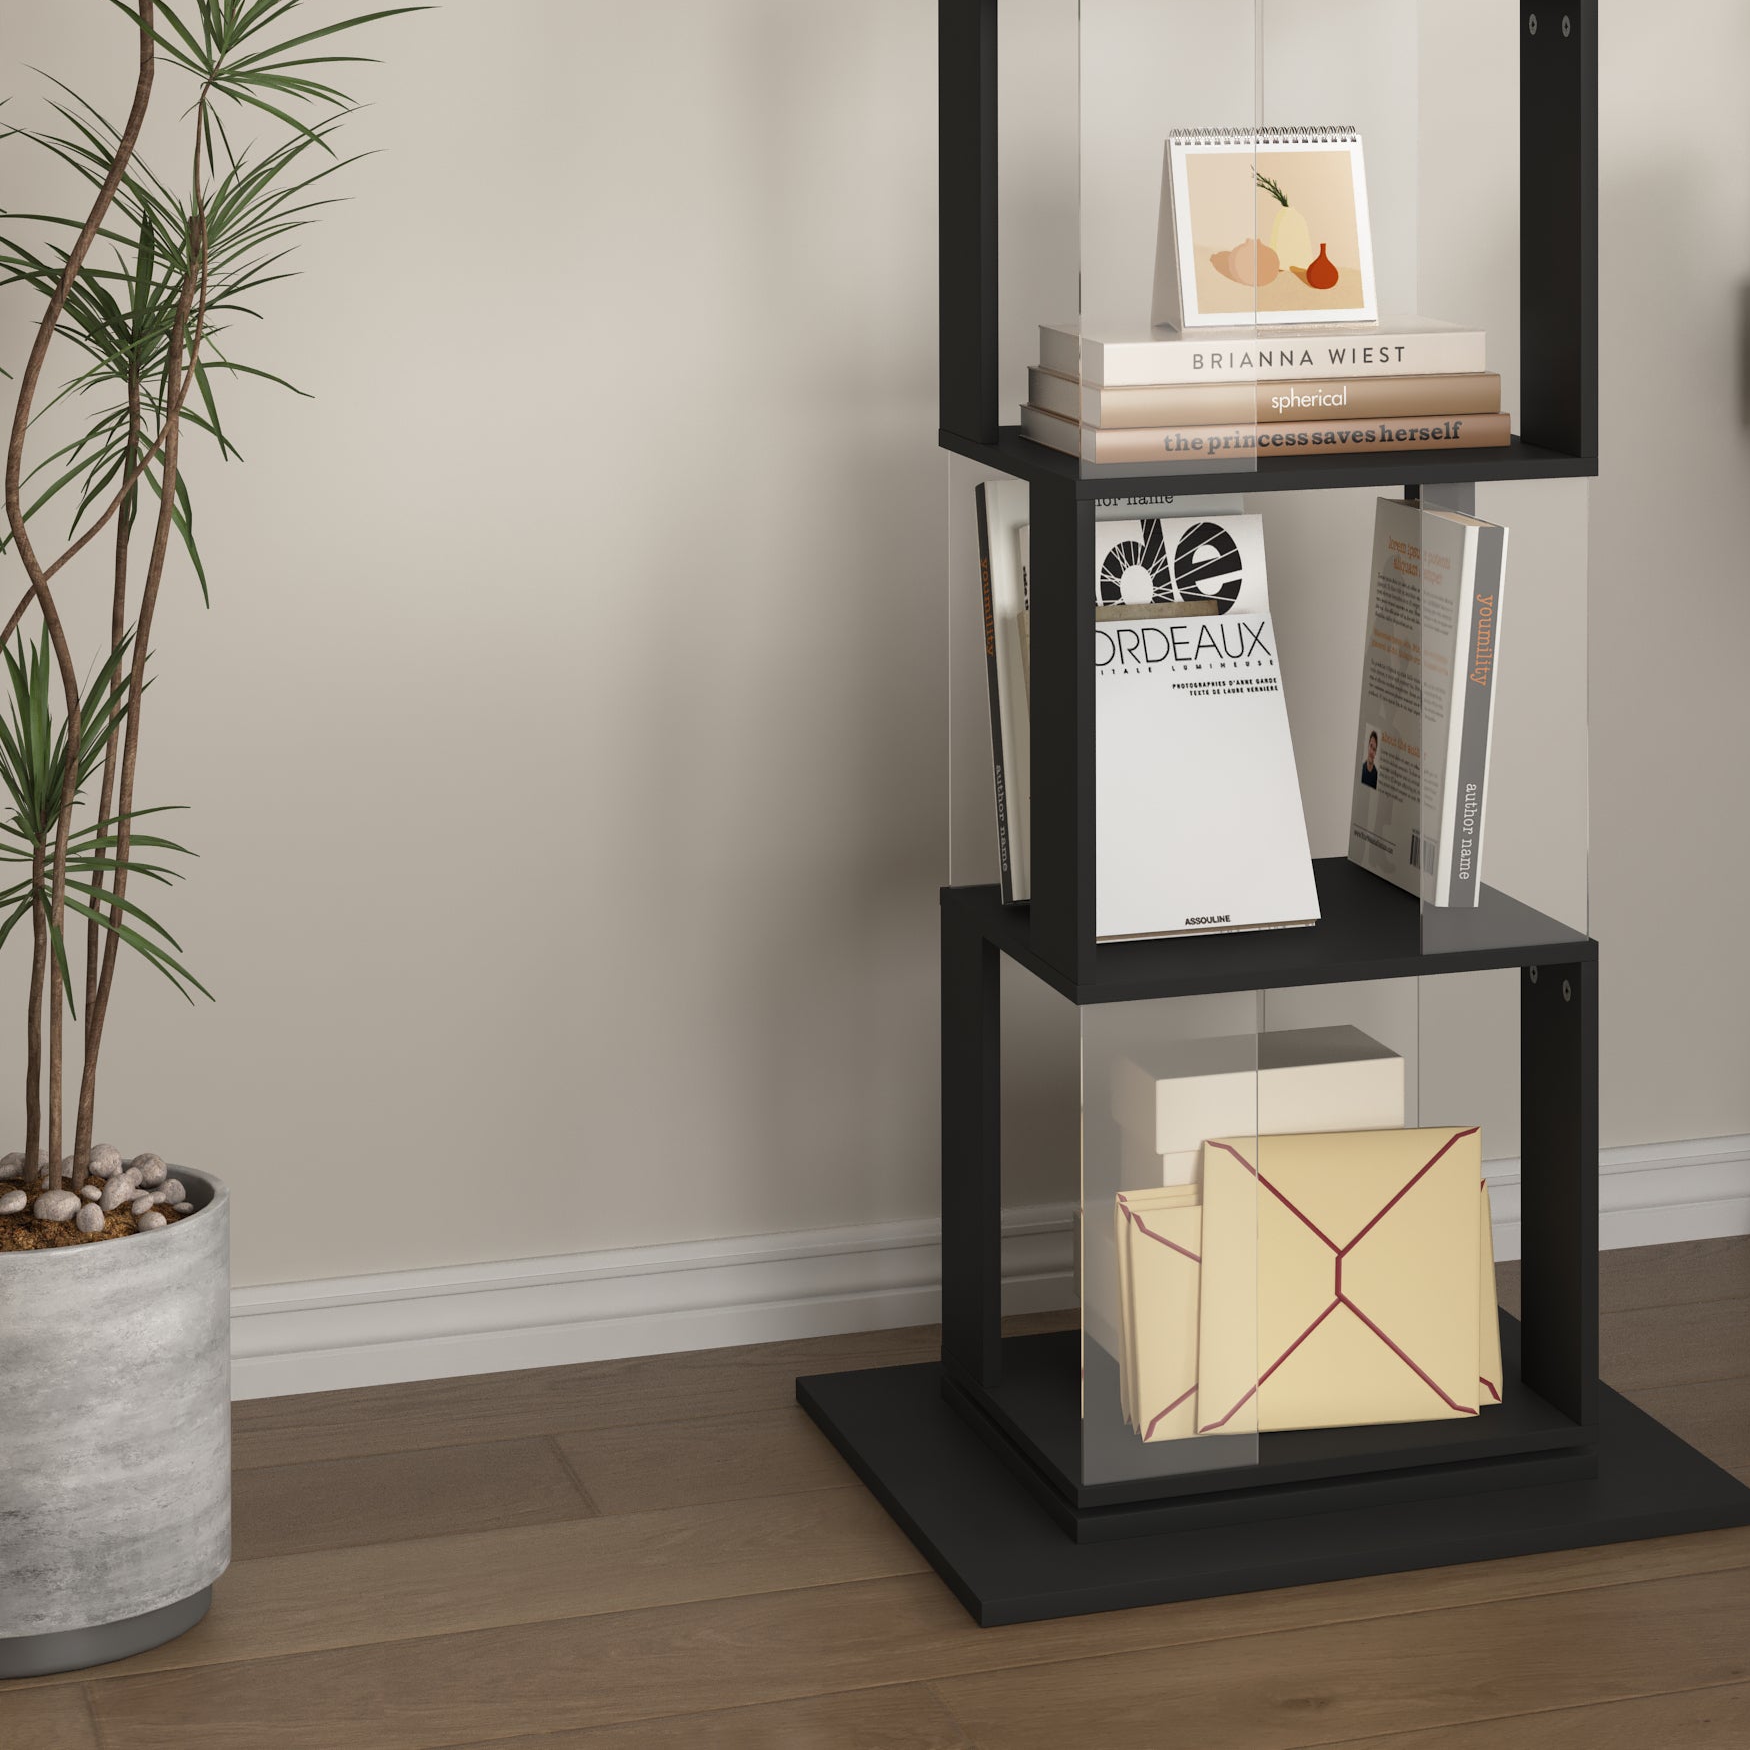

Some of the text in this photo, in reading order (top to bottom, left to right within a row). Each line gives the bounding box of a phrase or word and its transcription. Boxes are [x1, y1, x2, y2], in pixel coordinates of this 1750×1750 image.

[1193, 346, 1405, 370] BRIANNA WIEST
[1271, 385, 1347, 414] spherical
[1164, 421, 1463, 455] the princess saves herself
[1095, 621, 1272, 667] ORDEAUX
[1470, 593, 1494, 686] youmility
[1100, 667, 1153, 676] ITALE
[1172, 680, 1226, 690] PHOTOGRAPHIES
[1255, 677, 1277, 685] GARDE
[1459, 783, 1477, 880] author name
[1185, 915, 1231, 926] ASSOULINE
